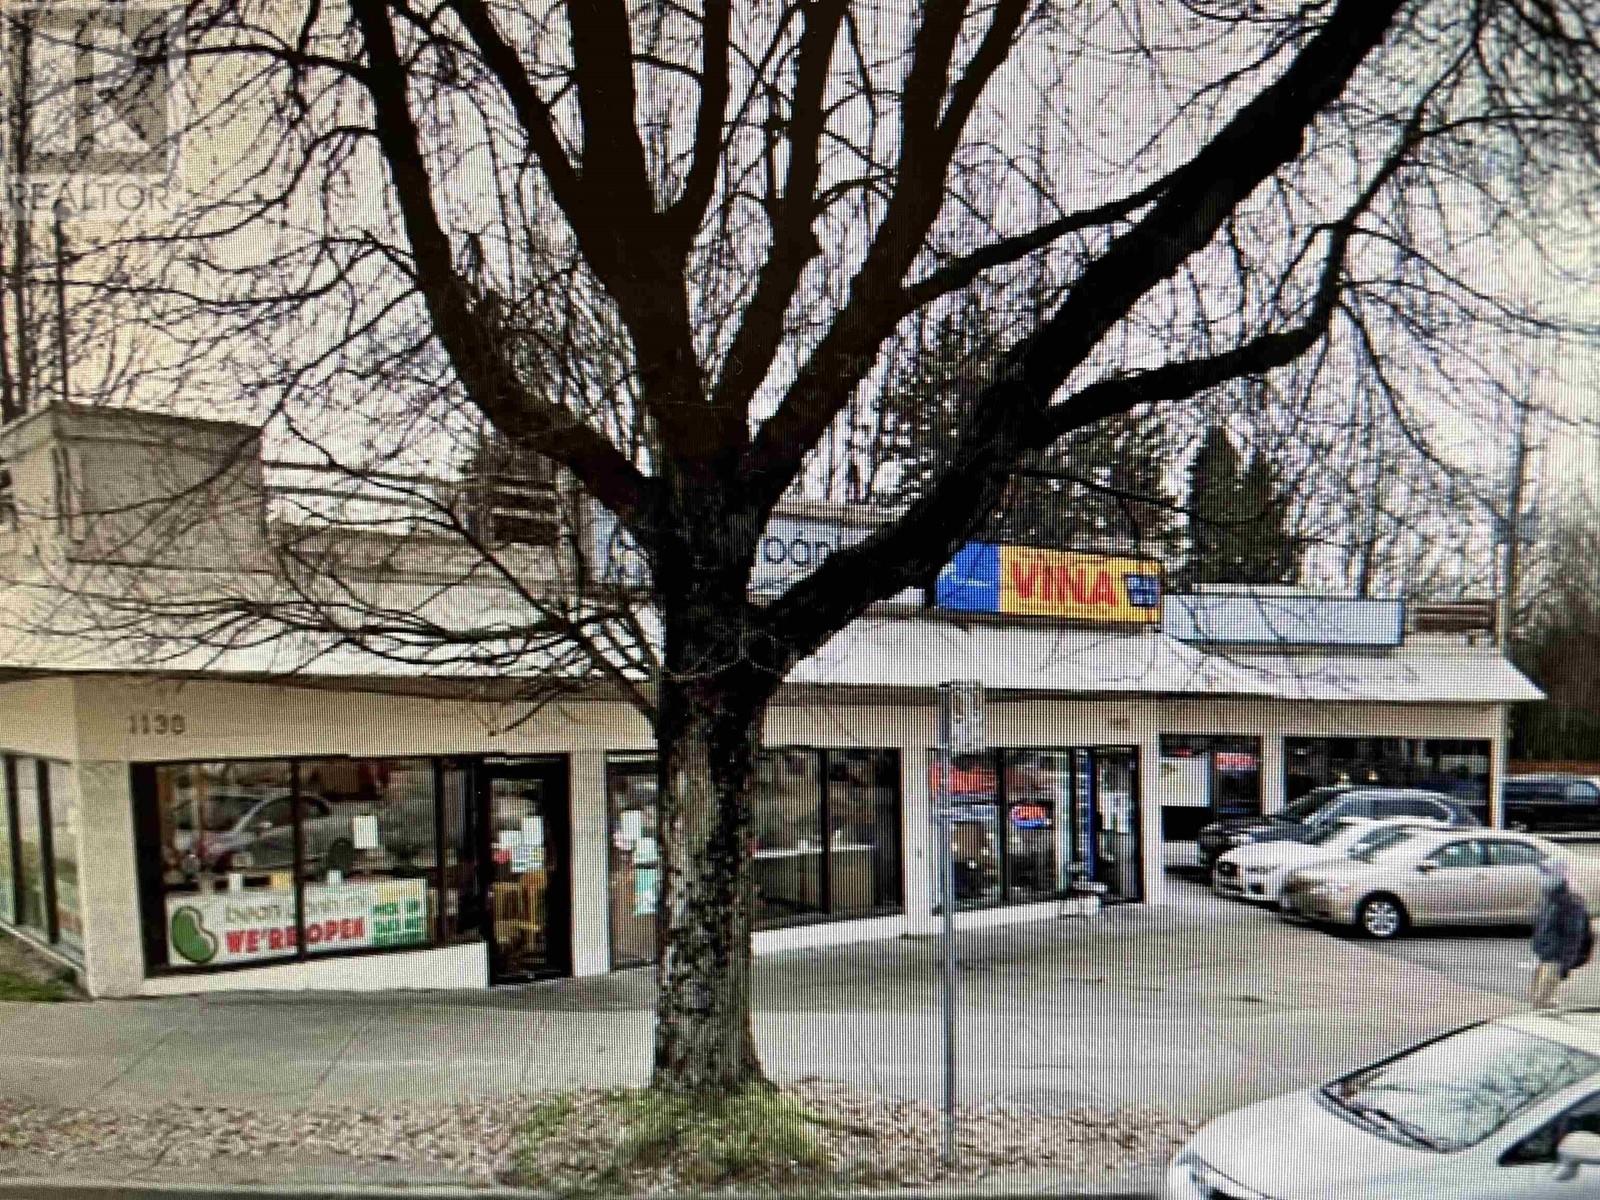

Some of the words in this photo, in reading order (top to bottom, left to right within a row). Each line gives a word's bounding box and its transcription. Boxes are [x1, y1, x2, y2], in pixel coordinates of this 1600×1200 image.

[1011, 559, 1118, 608] VINA
[129, 713, 185, 735] 1130
[305, 916, 365, 943] OPEN
